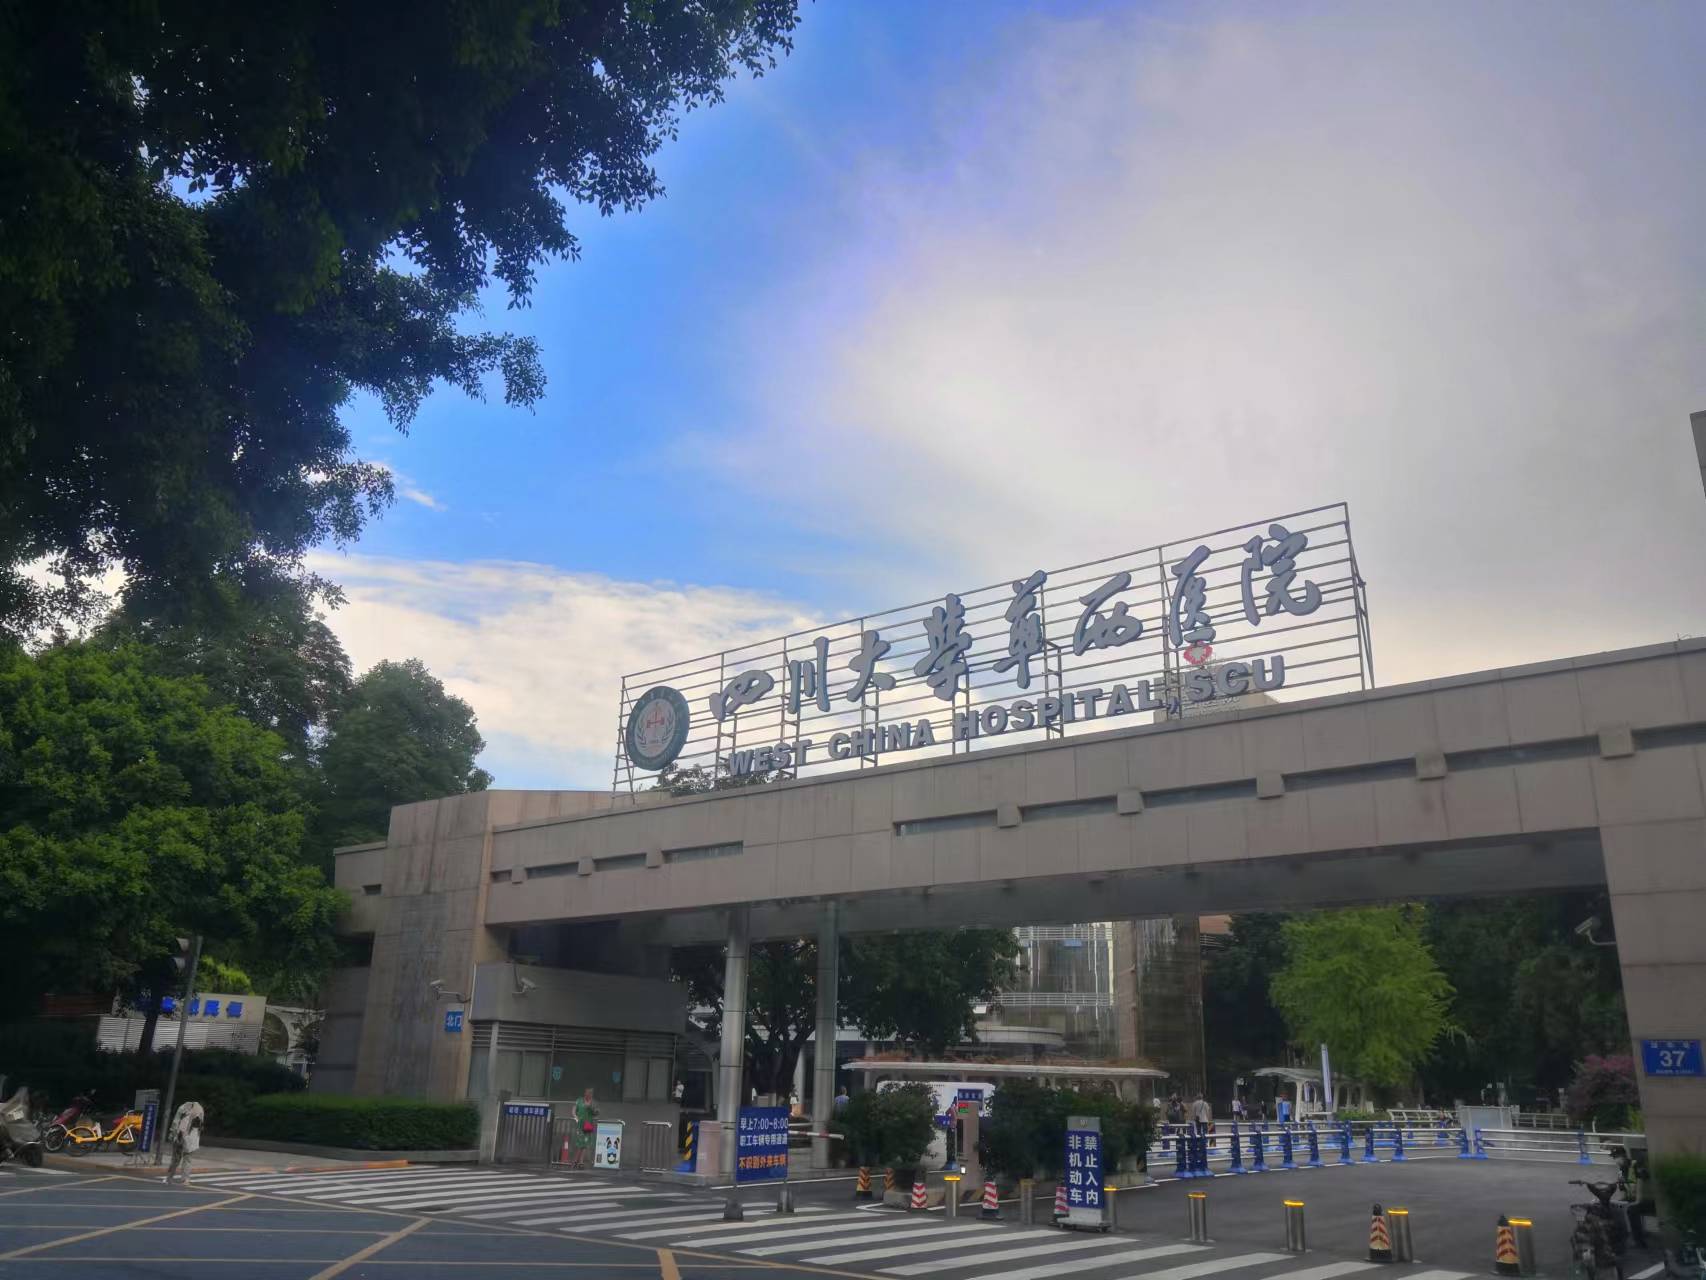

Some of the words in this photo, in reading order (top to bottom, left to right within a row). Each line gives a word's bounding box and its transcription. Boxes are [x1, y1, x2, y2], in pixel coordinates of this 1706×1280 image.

[728, 738, 813, 776] WEST
[828, 719, 936, 760] CHINA
[1659, 1050, 1686, 1067] 37
[1068, 1134, 1083, 1204] 非机动车
[1084, 1135, 1099, 1205] 禁止入内
